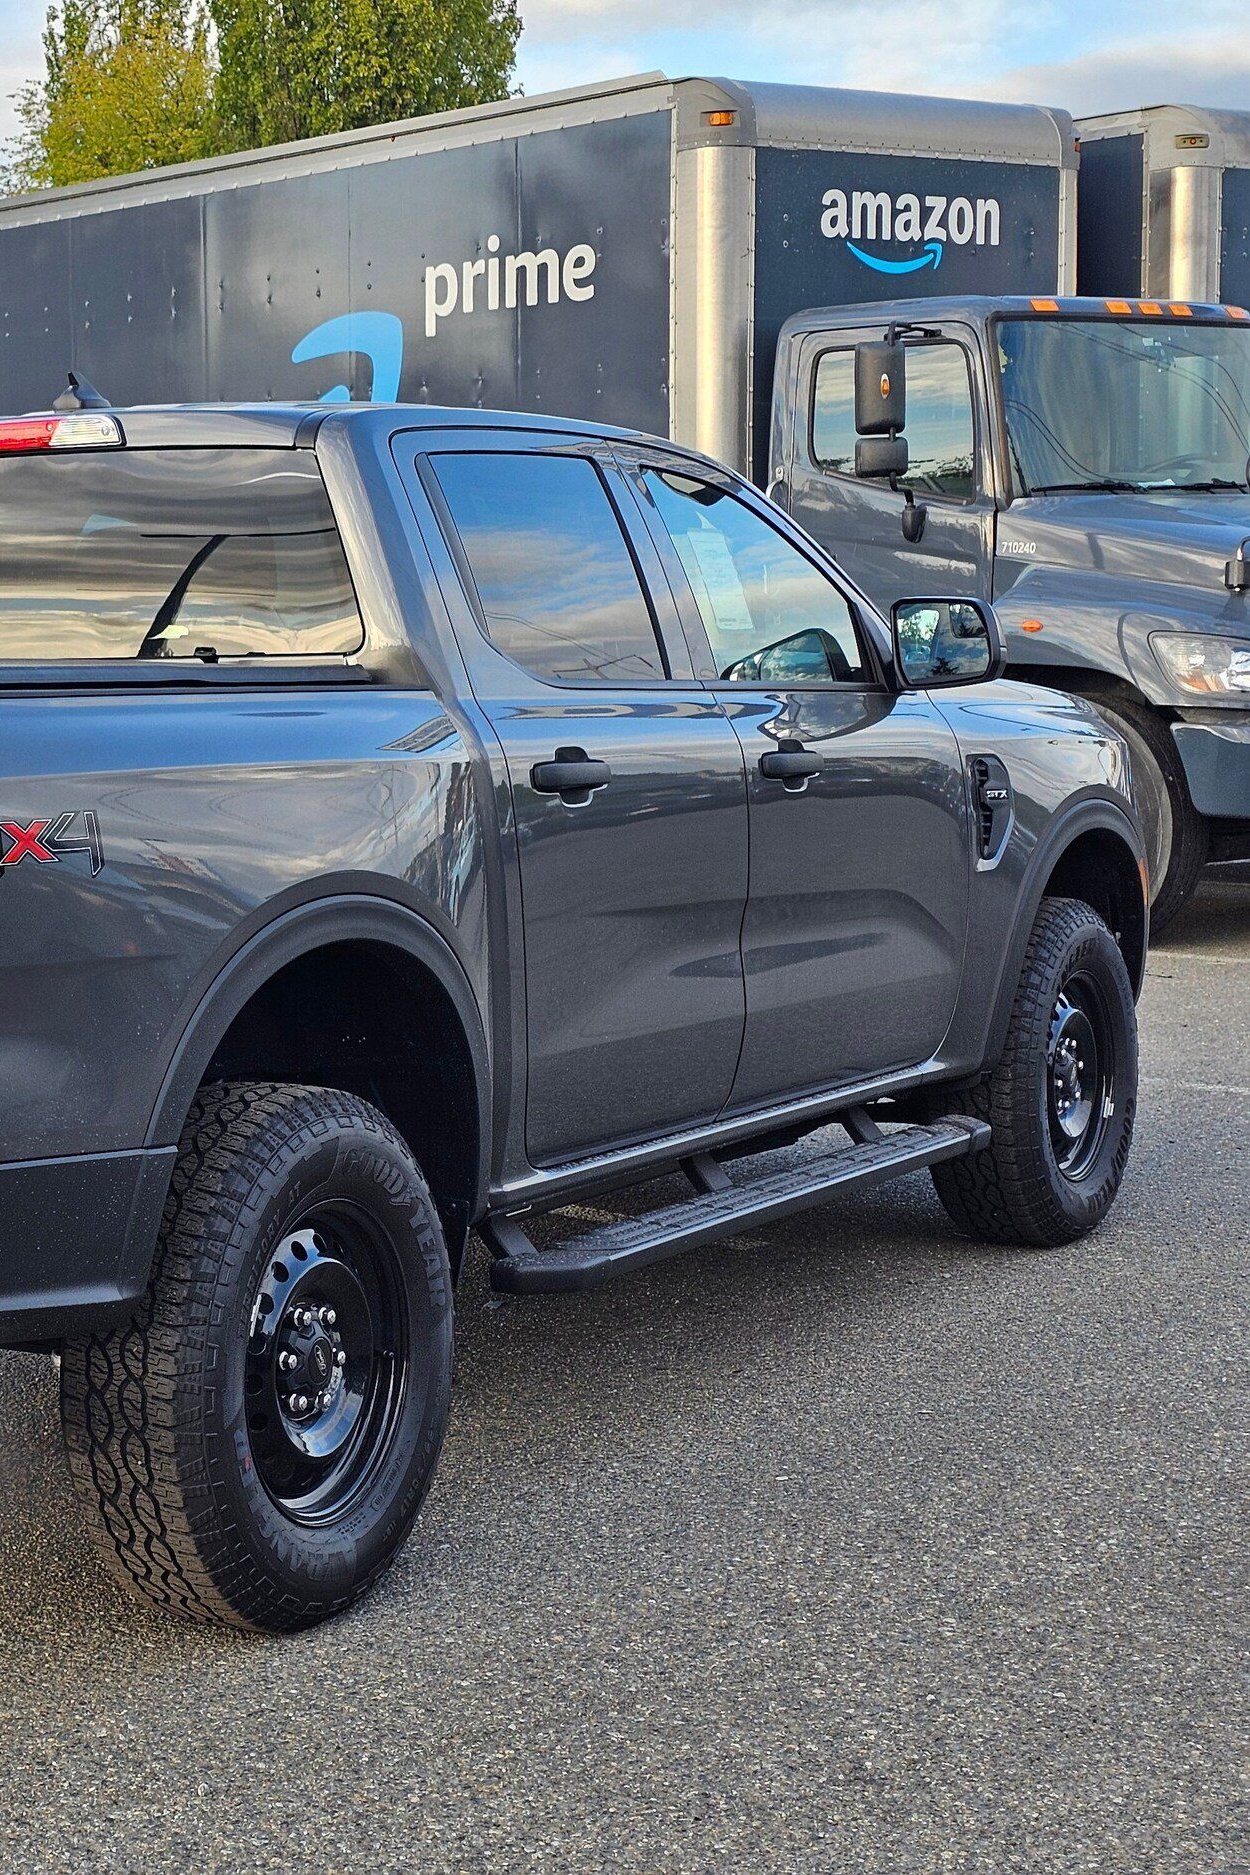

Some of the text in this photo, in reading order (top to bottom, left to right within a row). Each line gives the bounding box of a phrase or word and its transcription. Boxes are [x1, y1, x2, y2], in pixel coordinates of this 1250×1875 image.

[820, 188, 1000, 246] amazon
[425, 234, 596, 337] prime
[1002, 542, 1037, 554] 710240
[986, 790, 1008, 799] STX
[343, 1147, 447, 1308] GOODYEAR
